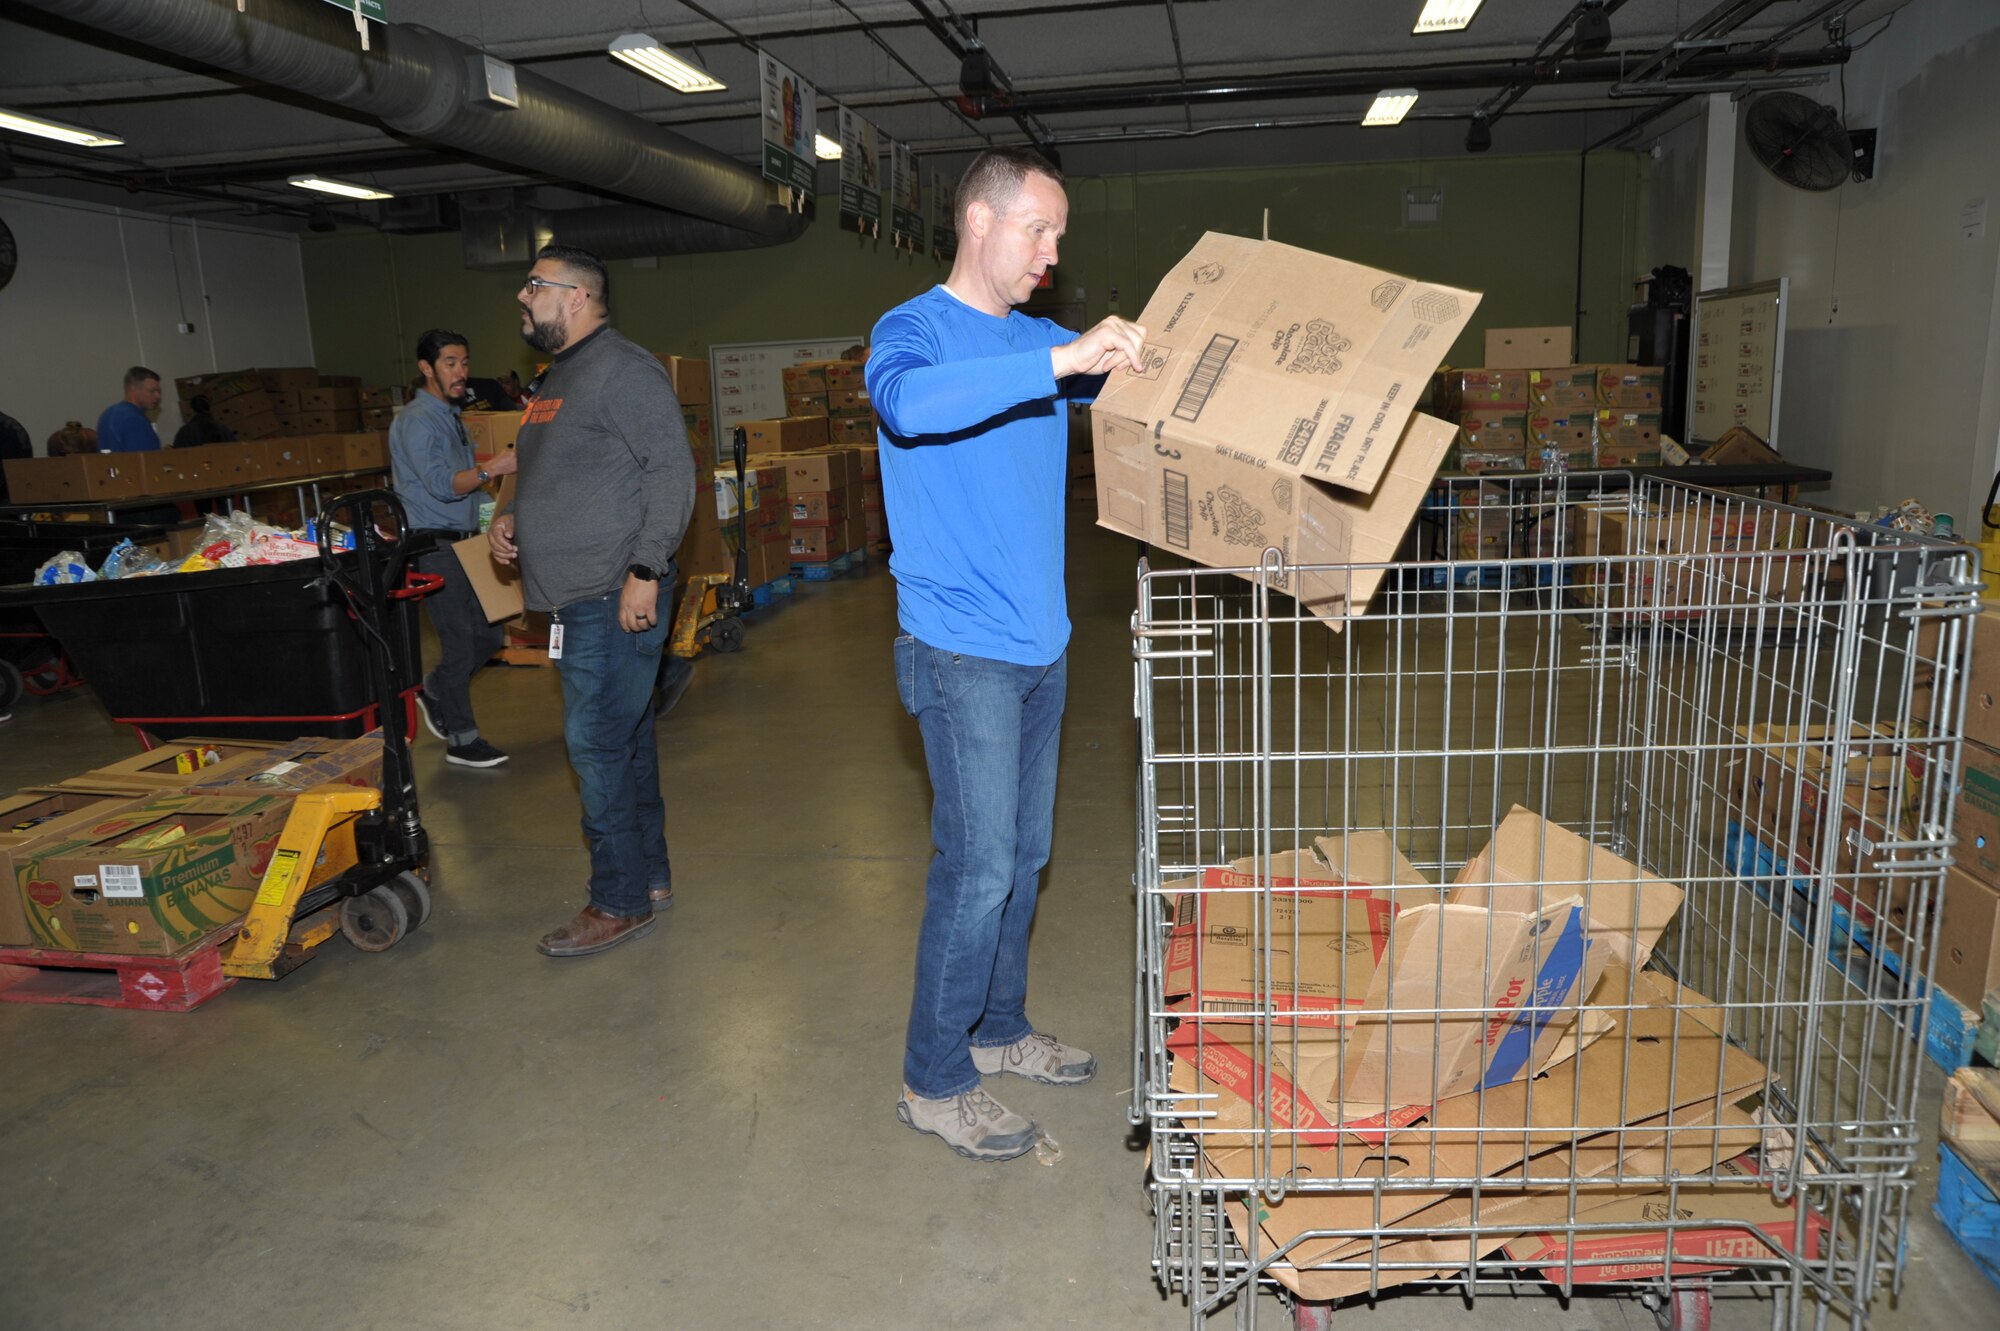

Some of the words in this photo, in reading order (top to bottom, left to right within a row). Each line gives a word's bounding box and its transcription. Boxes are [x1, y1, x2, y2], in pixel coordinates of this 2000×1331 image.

[1271, 330, 1285, 350] Chip
[1275, 323, 1301, 366] Chocolate
[1286, 318, 1335, 374] Batch
[1318, 332, 1352, 375] Soft
[1386, 383, 1402, 402] KEEP
[1312, 399, 1328, 421] 30100
[1379, 402, 1391, 412] IN
[1154, 443, 1181, 461] 3
[1285, 419, 1316, 465] 54085
[1315, 414, 1355, 473] FRAGILE
[1360, 437, 1374, 454] DRY
[1216, 444, 1233, 459] SOFT
[1233, 449, 1255, 466] BATCH
[1256, 458, 1267, 470] CC
[1346, 454, 1366, 480] PLACE
[1198, 499, 1208, 521] Chip
[1206, 491, 1220, 537] Chocolate
[262, 550, 303, 558] Valentine
[268, 542, 280, 551] Be
[285, 543, 300, 553] My
[162, 857, 220, 890] Premium
